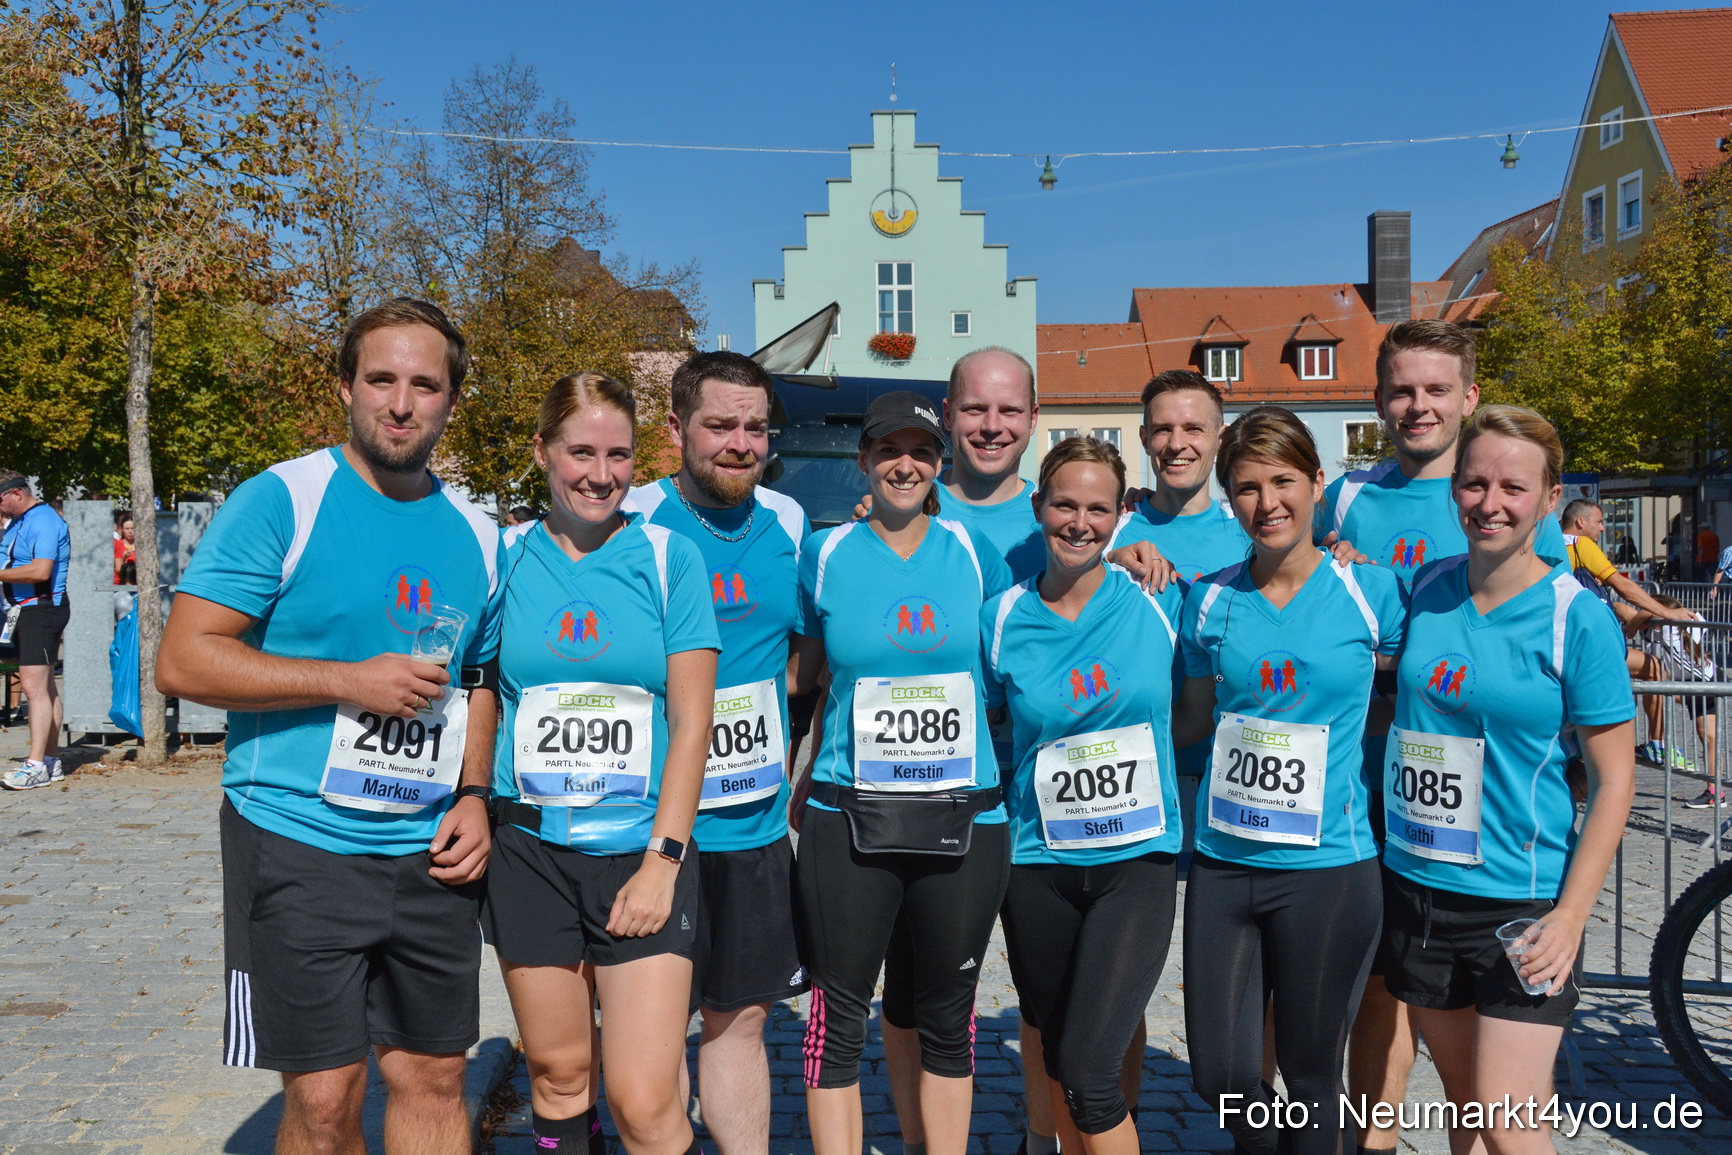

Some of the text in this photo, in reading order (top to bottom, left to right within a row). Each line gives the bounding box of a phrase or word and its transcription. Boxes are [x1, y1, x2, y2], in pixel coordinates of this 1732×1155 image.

[558, 693, 616, 708] BOCK
[891, 686, 946, 700] BOCK
[713, 696, 753, 713] OCK
[537, 716, 633, 755] 2090
[874, 708, 960, 744] 2086
[353, 711, 442, 762] 2091
[707, 714, 768, 760] 084
[1242, 727, 1291, 747] BOCK
[911, 748, 945, 757] Neumarkt
[1067, 740, 1118, 760] BOCK
[1398, 741, 1445, 760] BOCK
[358, 758, 425, 775] PARTL Neumarkt
[575, 760, 614, 768] Neukt
[705, 757, 759, 773] ARTL Neumarkt
[893, 764, 943, 779] Kerstin
[1225, 747, 1306, 795] 2083
[362, 778, 420, 801] Markus
[721, 777, 756, 793] Bene
[1051, 760, 1138, 803] 2087
[1391, 761, 1462, 810] 2085
[1227, 788, 1284, 807] PARTL Neumarkt
[1091, 802, 1127, 813] Neumarkt
[1410, 808, 1443, 822] Neumarkt
[1084, 818, 1123, 836] Steffi
[1240, 808, 1269, 828] Lisa
[1404, 823, 1434, 845] Kathi
